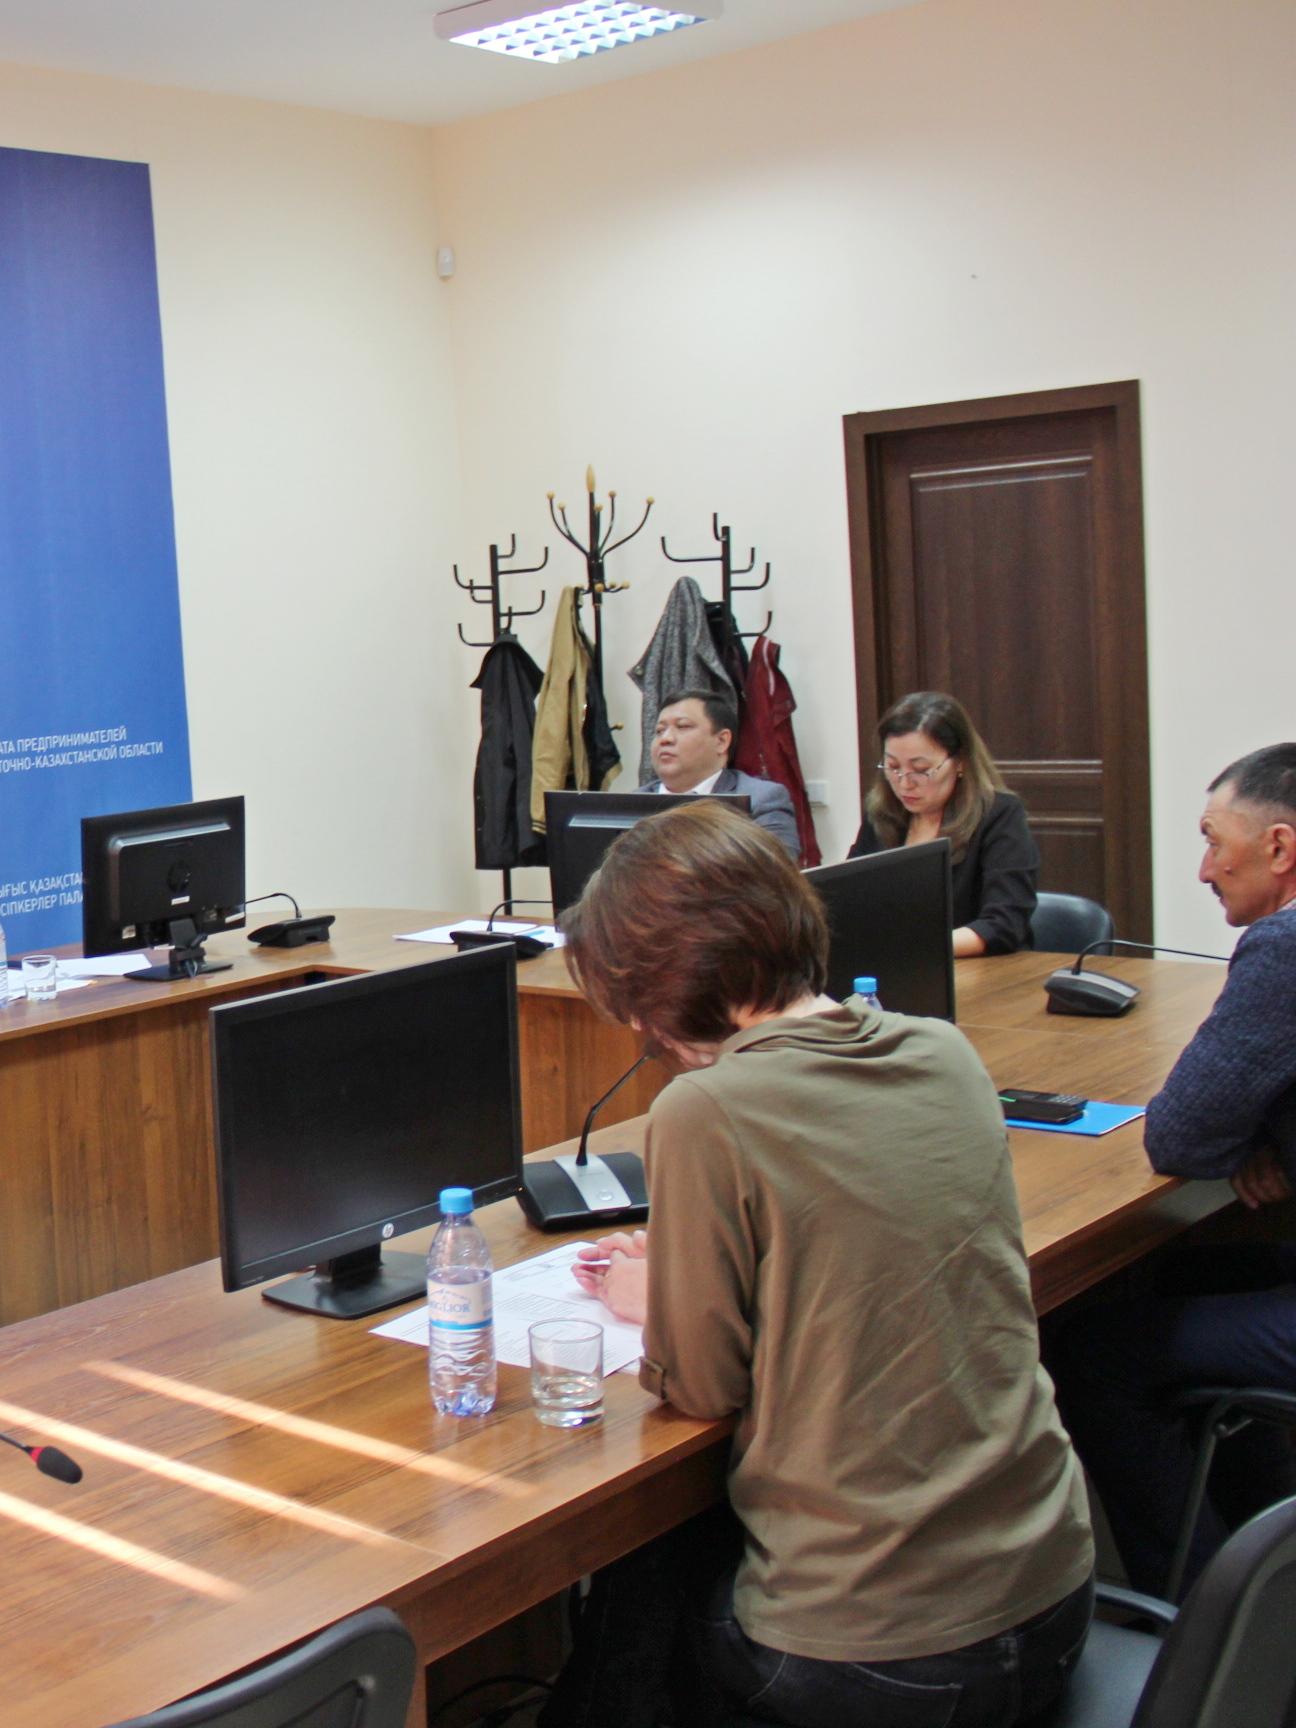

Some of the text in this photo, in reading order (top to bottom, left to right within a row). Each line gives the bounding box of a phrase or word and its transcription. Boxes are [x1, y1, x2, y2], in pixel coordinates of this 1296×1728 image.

[16, 725, 128, 753] ПРЕДПРИНИМАТЕЛЕЙ
[119, 741, 164, 760] ОБЛАСТИ
[29, 871, 83, 895] ҚАЗАҚСТА
